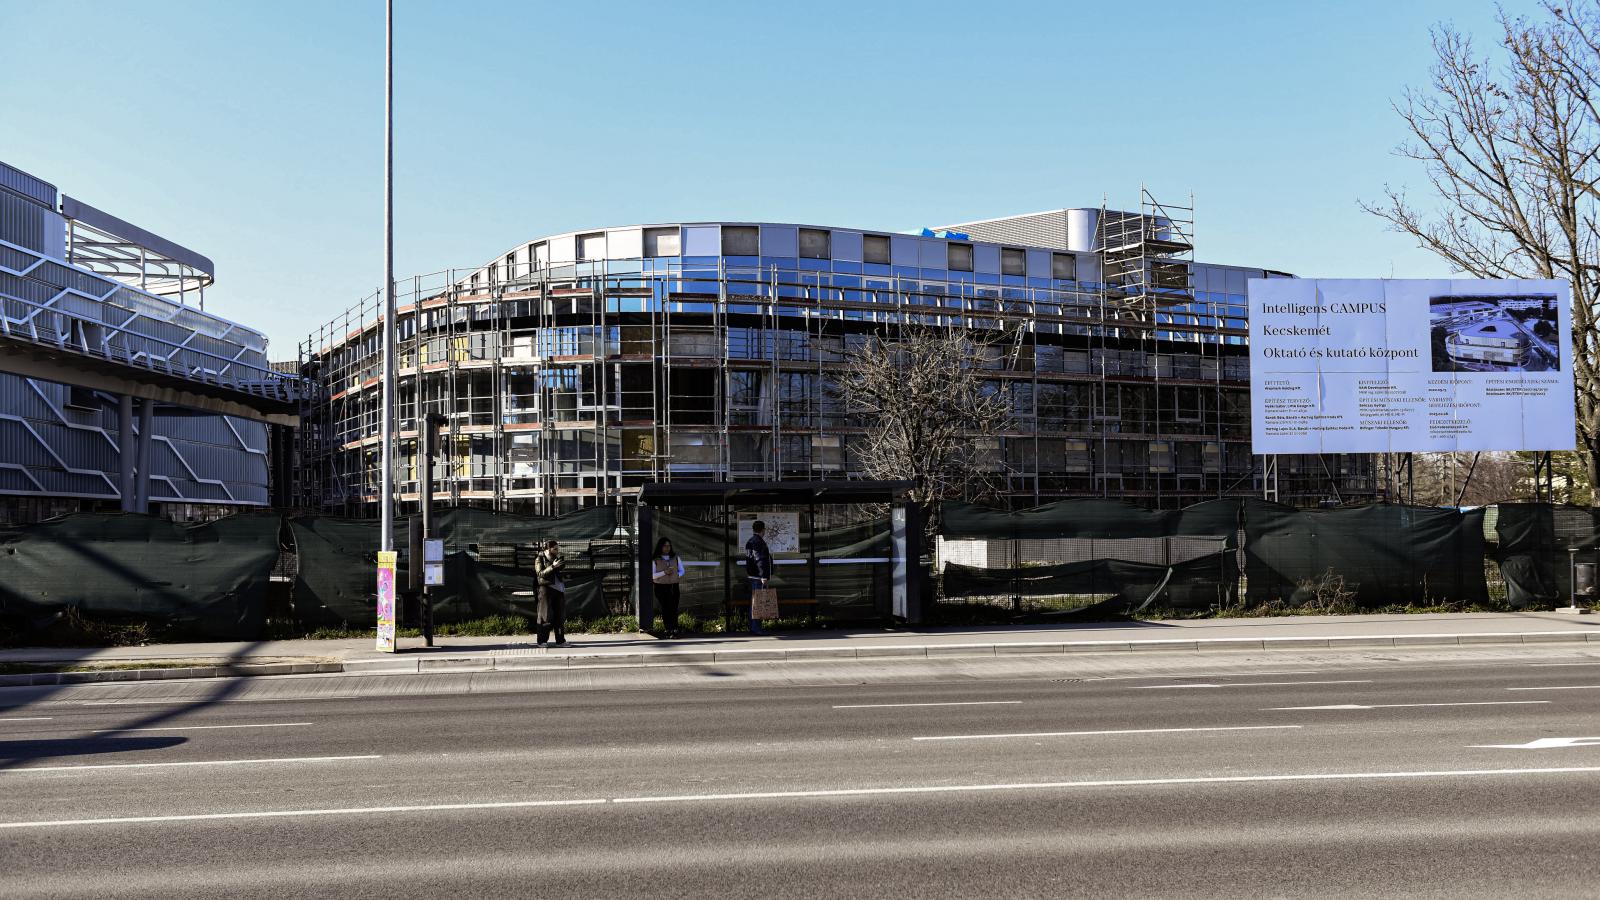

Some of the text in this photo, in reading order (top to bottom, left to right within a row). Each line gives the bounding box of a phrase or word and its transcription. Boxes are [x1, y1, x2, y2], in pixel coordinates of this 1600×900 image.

[1262, 302, 1387, 316] Intelligens CAMPUS
[1263, 324, 1331, 336] Kecskemét
[1263, 347, 1418, 360] Oktató és kutató központ
